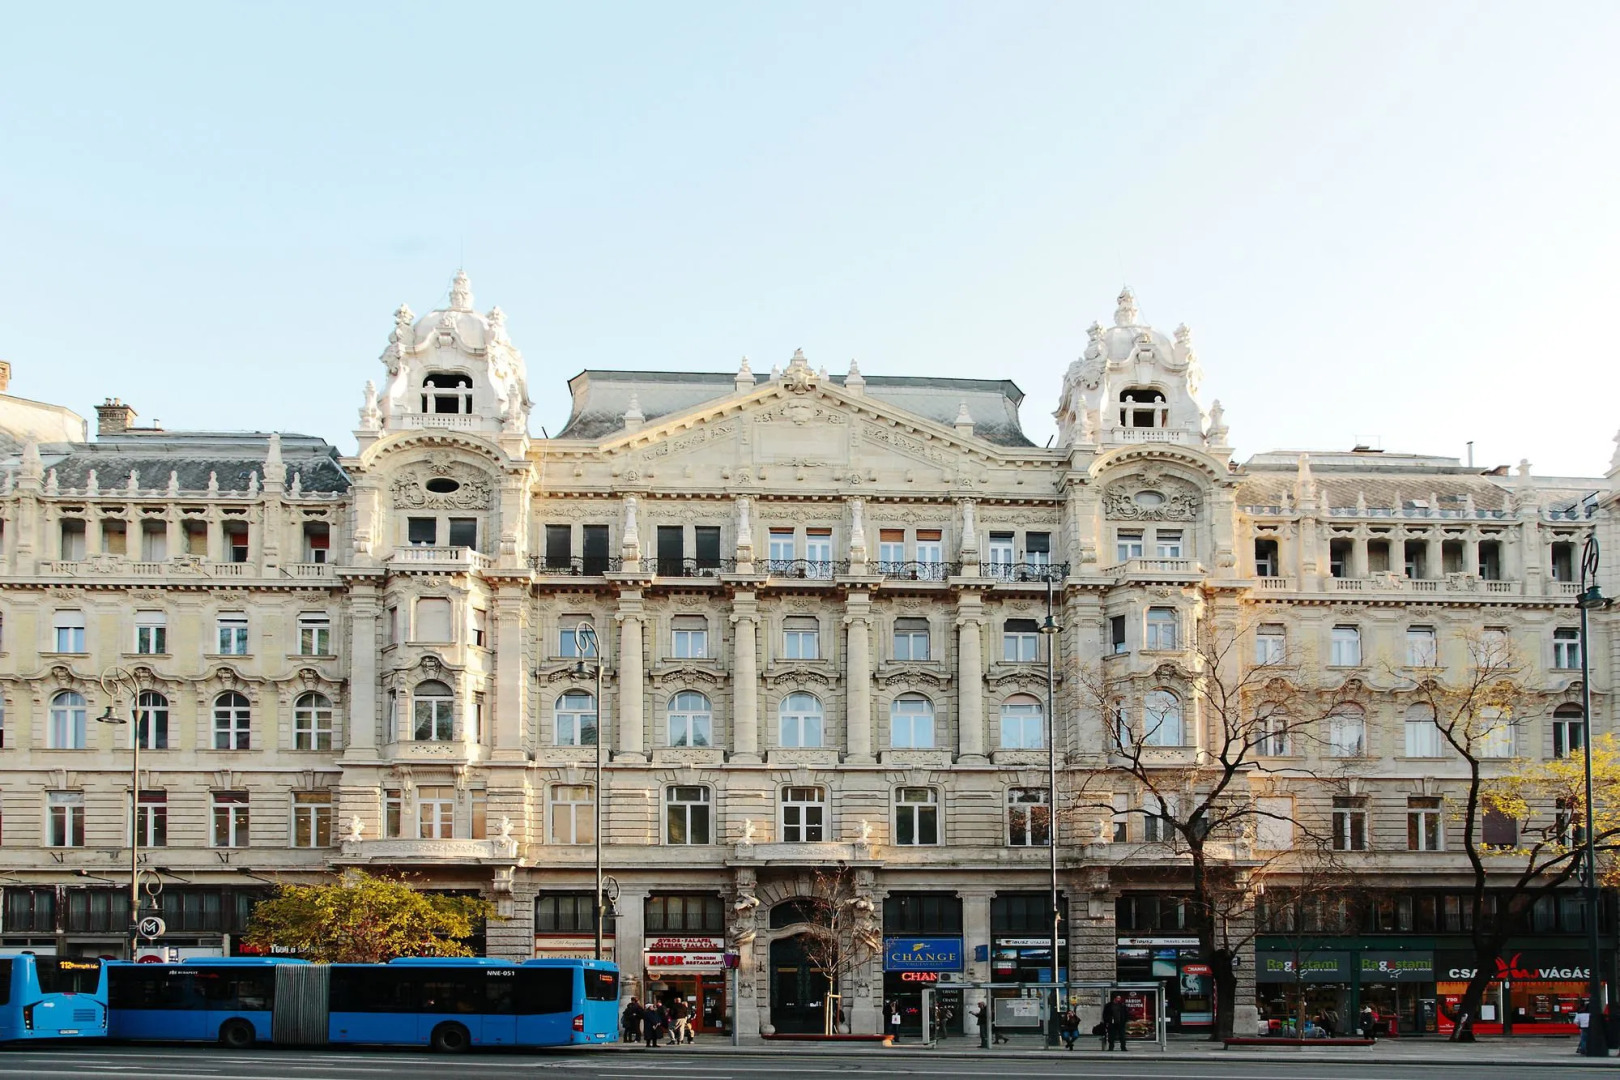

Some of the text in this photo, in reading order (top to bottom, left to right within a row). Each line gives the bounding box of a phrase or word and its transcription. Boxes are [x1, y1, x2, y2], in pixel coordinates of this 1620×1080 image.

[649, 955, 684, 965] EKER
[891, 953, 956, 961] CHANGE
[902, 972, 938, 981] CHAN
